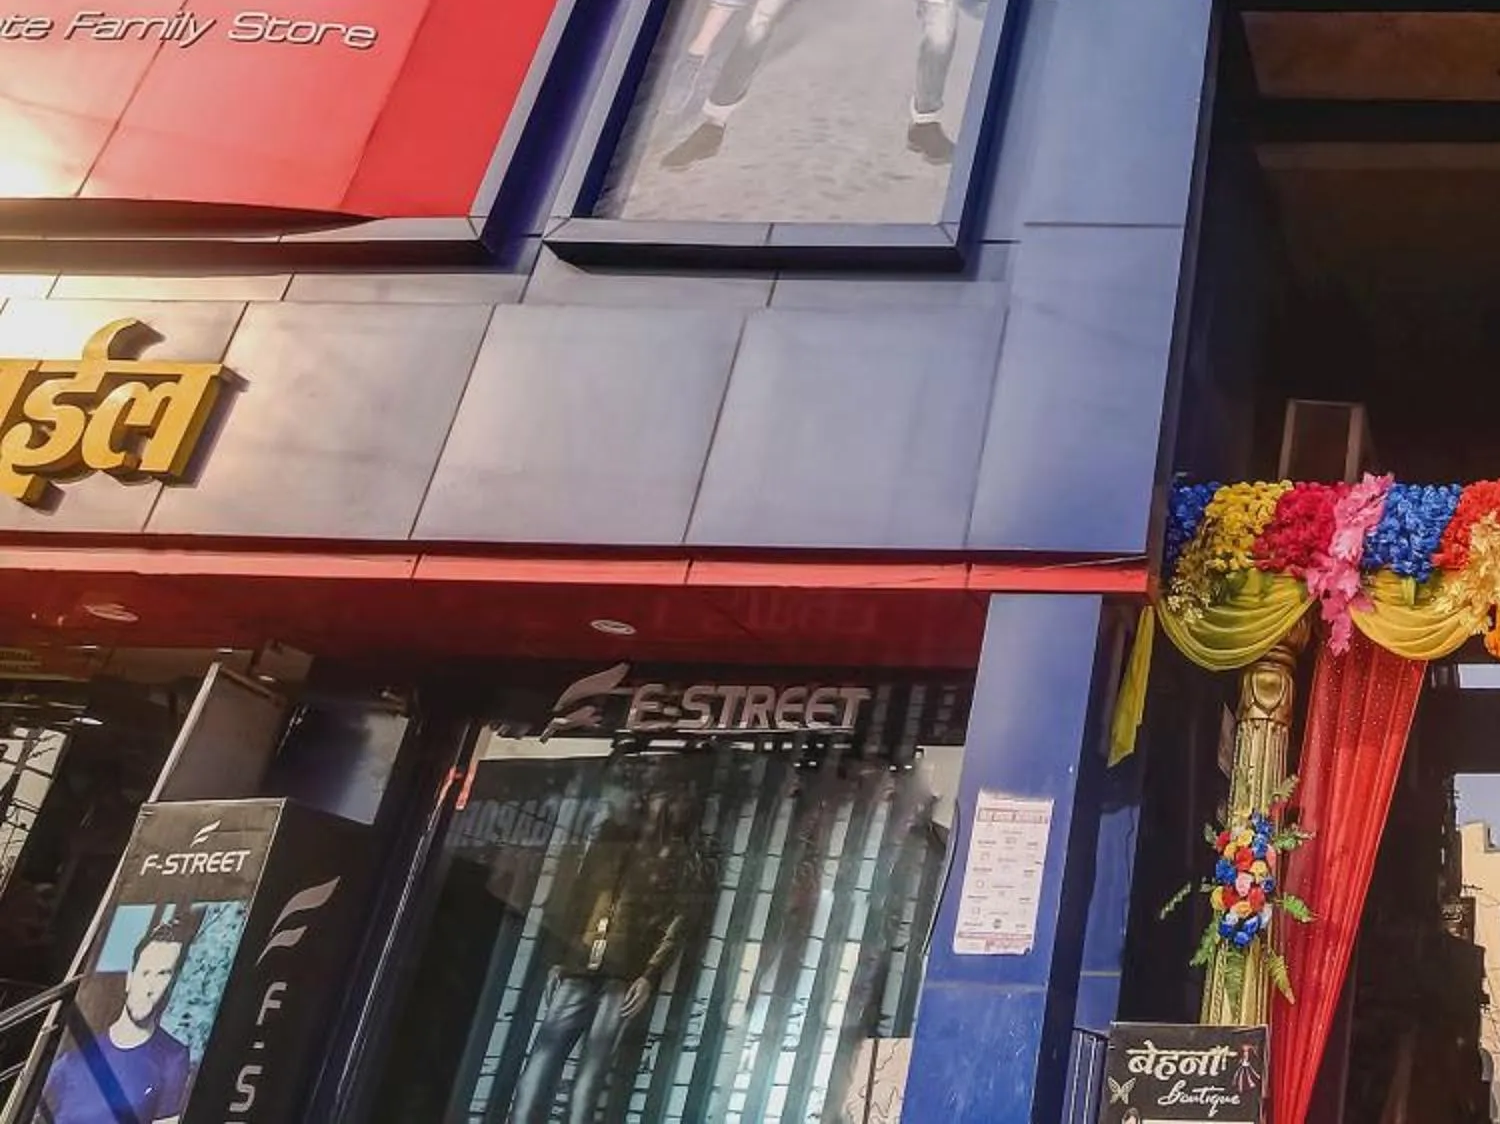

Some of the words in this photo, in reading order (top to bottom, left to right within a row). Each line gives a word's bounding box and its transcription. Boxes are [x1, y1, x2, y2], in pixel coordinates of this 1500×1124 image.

[0, 14, 53, 39] te
[64, 11, 216, 49] Family
[227, 11, 379, 49] Store
[140, 849, 251, 876] F-STREET
[228, 981, 289, 1124] F-S
[1157, 1079, 1241, 1118] Boutique
